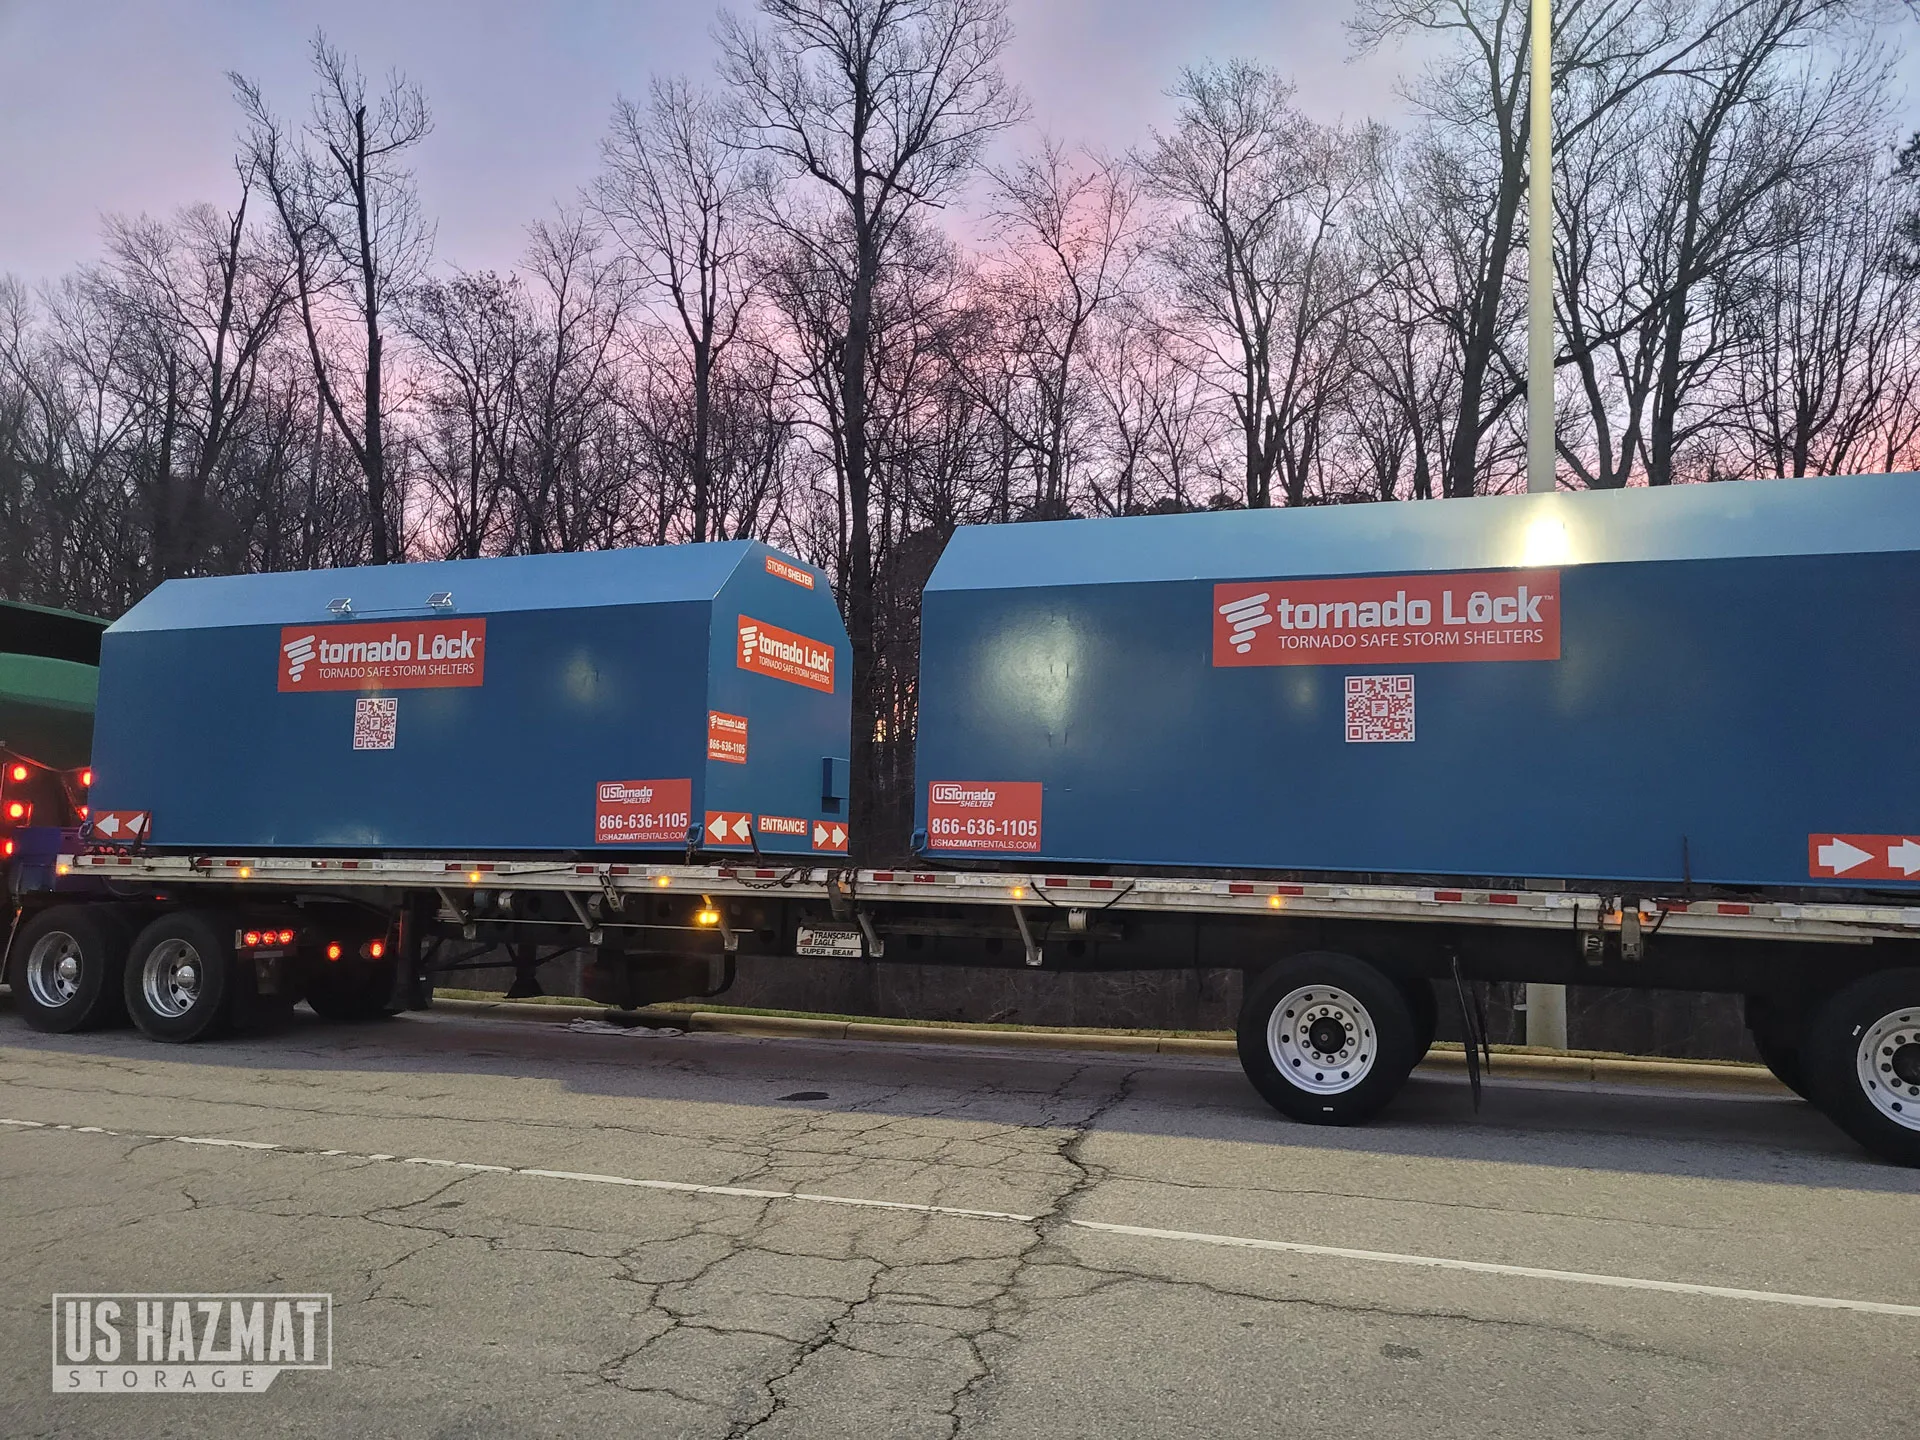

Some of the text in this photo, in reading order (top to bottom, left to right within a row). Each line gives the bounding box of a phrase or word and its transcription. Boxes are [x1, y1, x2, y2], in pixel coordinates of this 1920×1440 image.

[767, 560, 813, 587] STORM SHELTER
[1277, 590, 1431, 630] tornado
[1278, 629, 1544, 649] TORNADO SAFE STORM SHELTERS
[318, 634, 411, 664] tornado
[758, 632, 803, 665] tornado
[318, 663, 475, 679] TORNADO SAFE STORM SHELTERS
[758, 656, 830, 685] TORNADO SAFE STORM SHELTERS
[959, 800, 994, 808] SHELTER
[600, 812, 688, 830] 866-636-1105
[760, 817, 806, 833] ENTRANCE
[931, 818, 1038, 837] 866-636-1105
[598, 831, 687, 841] USHAZMATRENTALS.COM
[930, 838, 1037, 850] USHAZMATRENTALS.COM
[813, 938, 836, 947] EAGLE
[814, 931, 859, 941] TRANSCRAFT
[801, 947, 826, 955] SUPER
